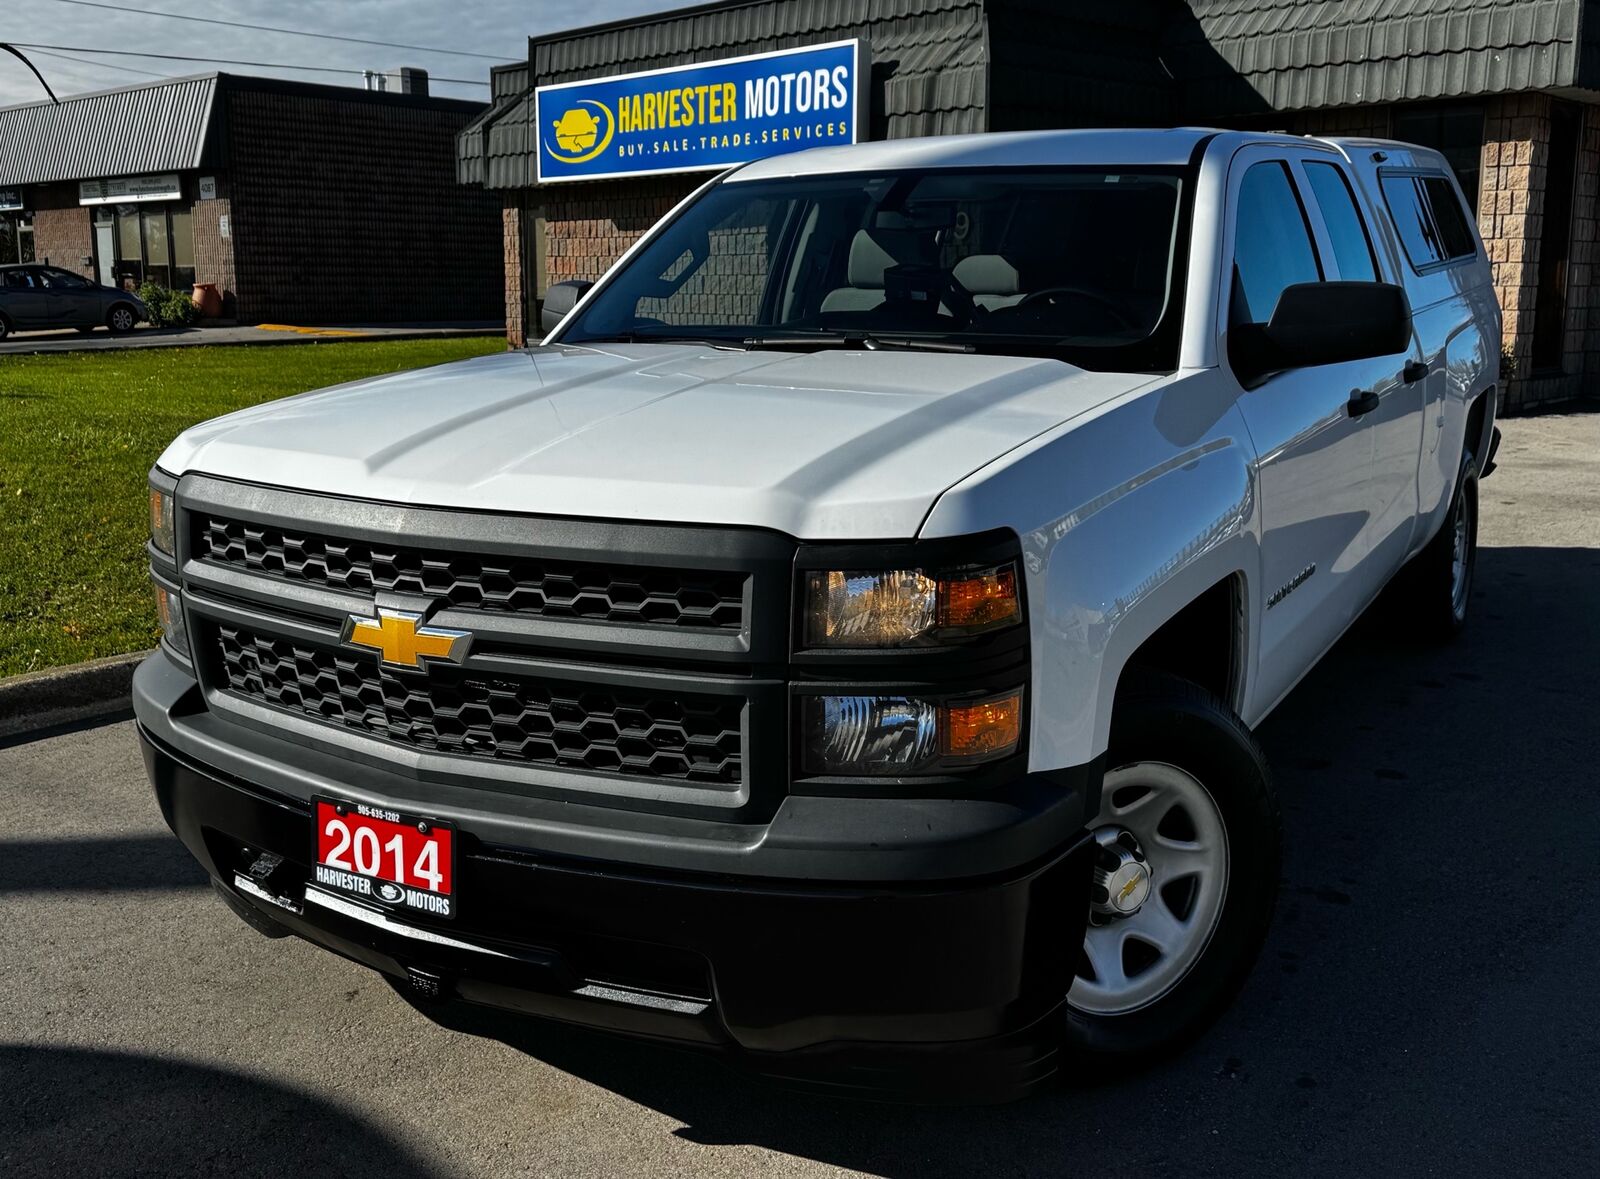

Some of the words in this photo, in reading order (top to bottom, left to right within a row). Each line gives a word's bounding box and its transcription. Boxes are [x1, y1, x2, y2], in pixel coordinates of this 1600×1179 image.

[618, 82, 737, 133] HARVESTER
[744, 65, 849, 120] MOTORS
[357, 805, 400, 823] 905-635-1202
[325, 819, 443, 892] 2014
[316, 866, 371, 895] HARVESTER
[406, 889, 450, 916] MOTORS
